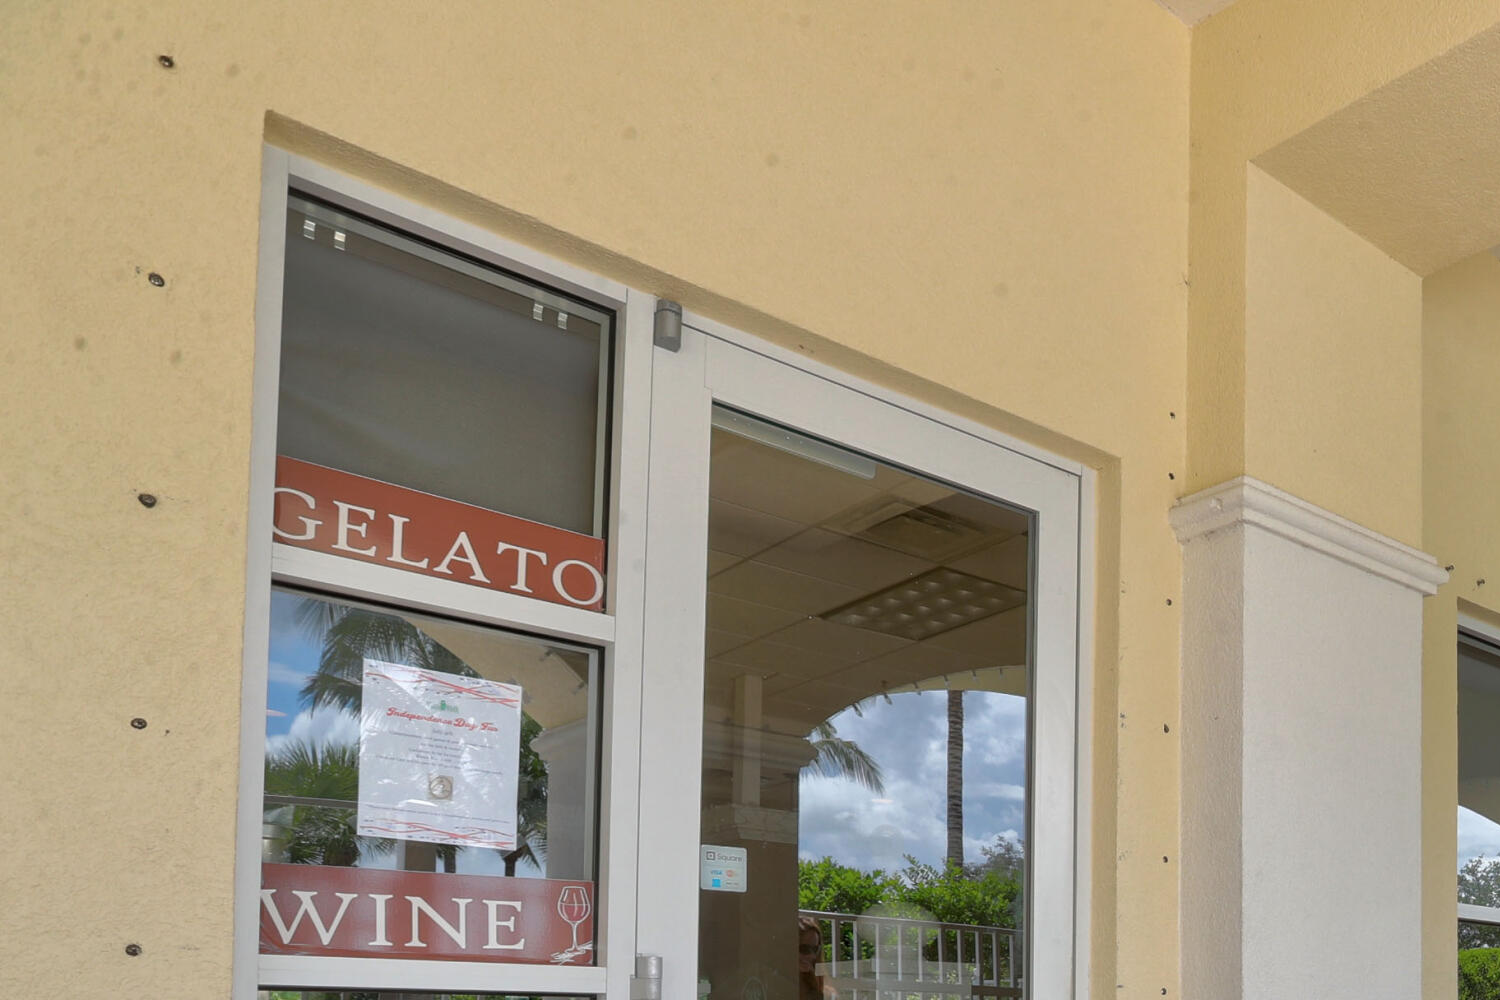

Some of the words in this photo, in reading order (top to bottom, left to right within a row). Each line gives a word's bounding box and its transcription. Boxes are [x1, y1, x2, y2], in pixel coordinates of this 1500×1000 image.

[272, 486, 604, 606] GELATO
[386, 706, 453, 726] Independence
[453, 717, 478, 732] Day
[259, 888, 526, 950] WINE
